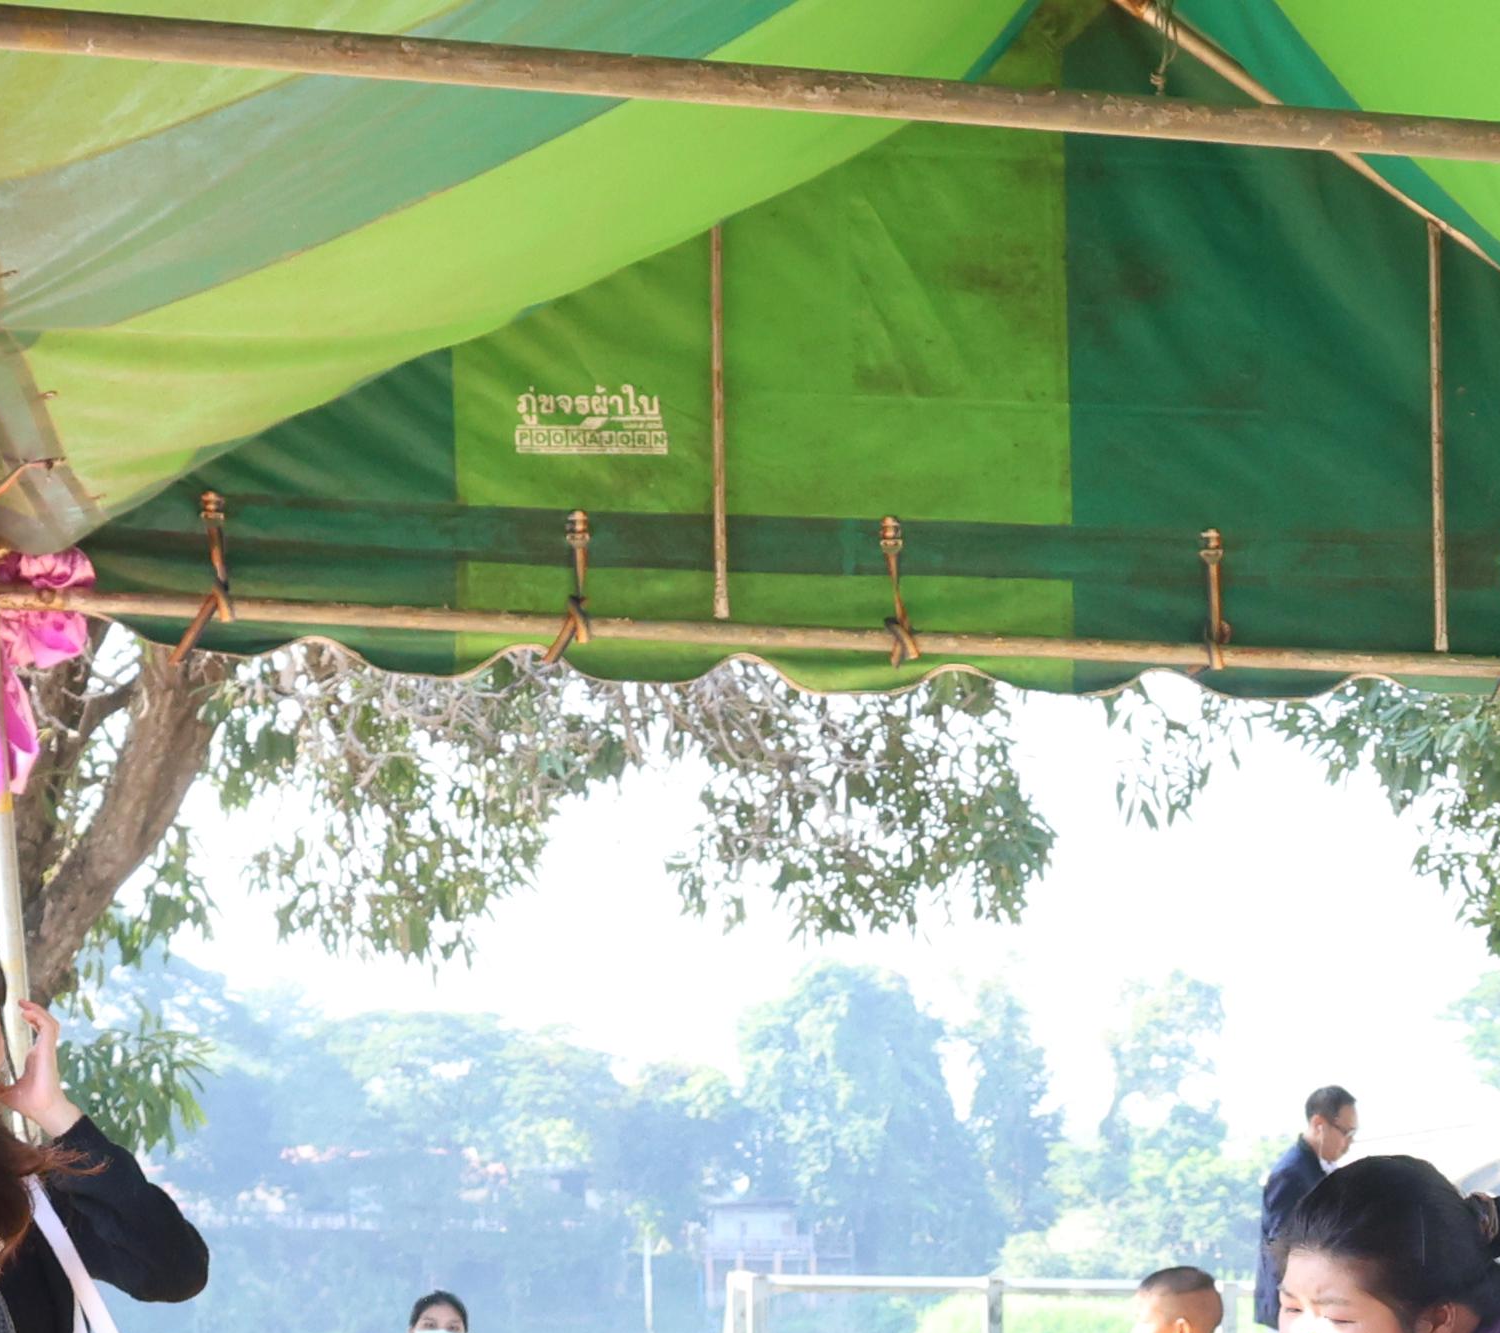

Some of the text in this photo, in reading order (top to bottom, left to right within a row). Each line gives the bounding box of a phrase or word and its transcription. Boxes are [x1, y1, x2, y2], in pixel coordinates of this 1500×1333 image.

[516, 384, 660, 425] ภู่ขจรผ้าใบ
[517, 431, 667, 447] POOKAJORN
